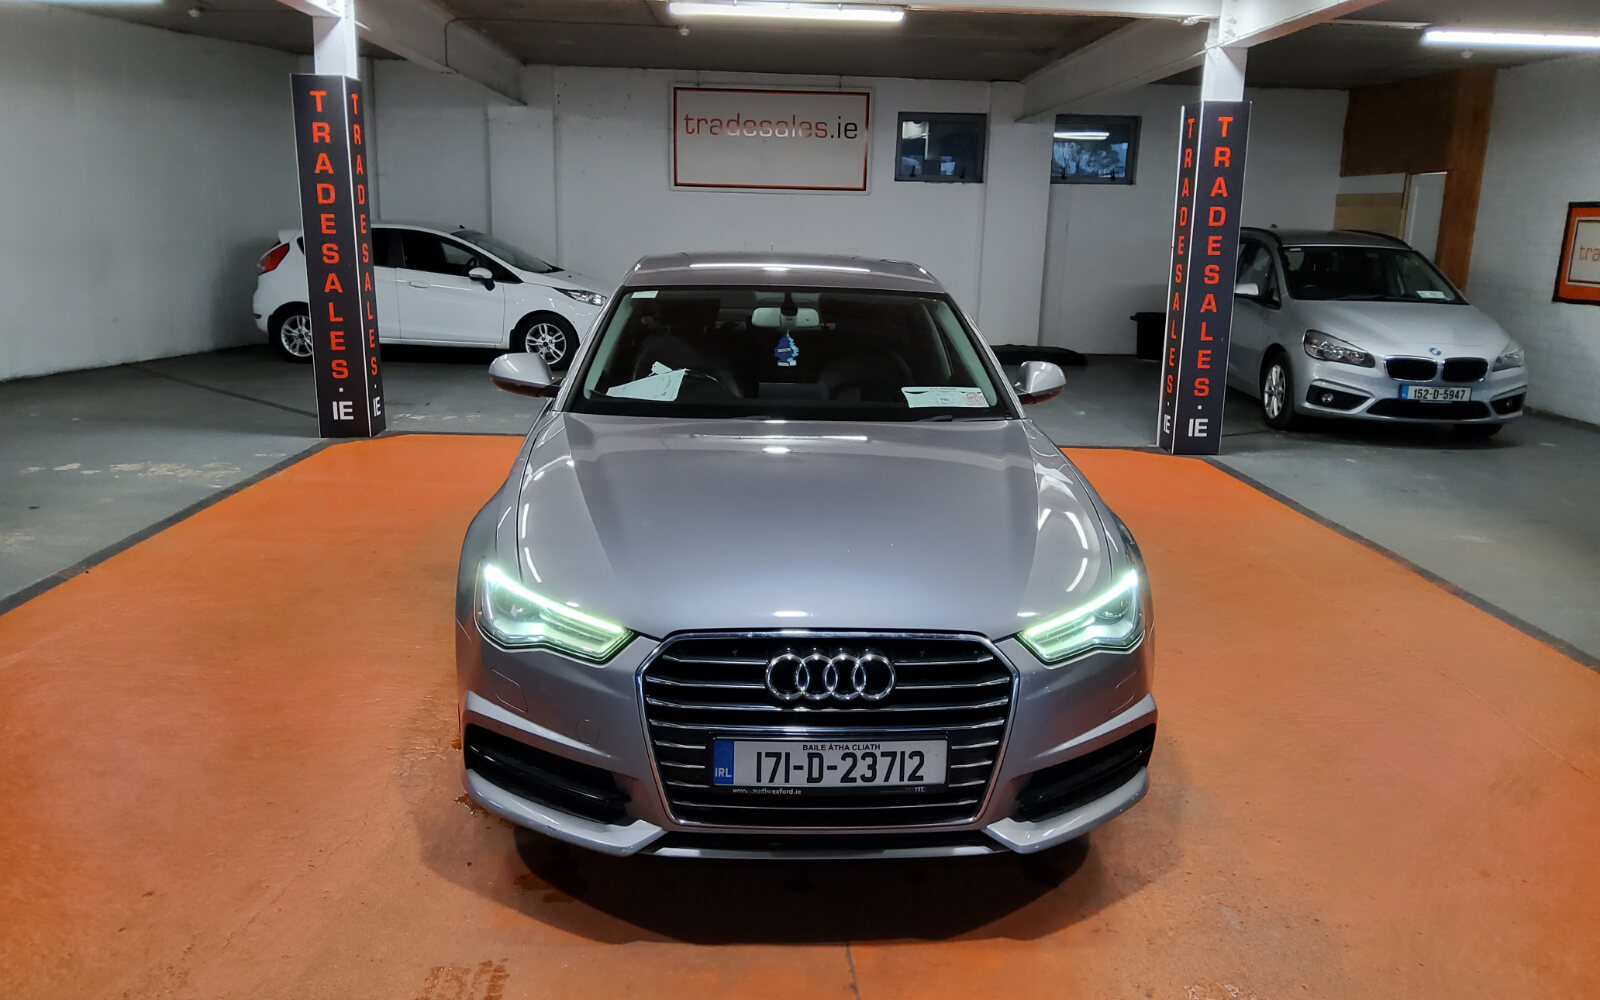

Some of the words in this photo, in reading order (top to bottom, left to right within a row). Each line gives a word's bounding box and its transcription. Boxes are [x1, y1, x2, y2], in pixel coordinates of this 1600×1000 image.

[684, 113, 858, 139] tradesales.ie
[1413, 388, 1466, 400] 152-D-5947
[828, 743, 851, 751] ÁTHA
[851, 743, 881, 751] CLIATH
[714, 767, 732, 778] IRL
[756, 750, 925, 784] 171-D-23712
